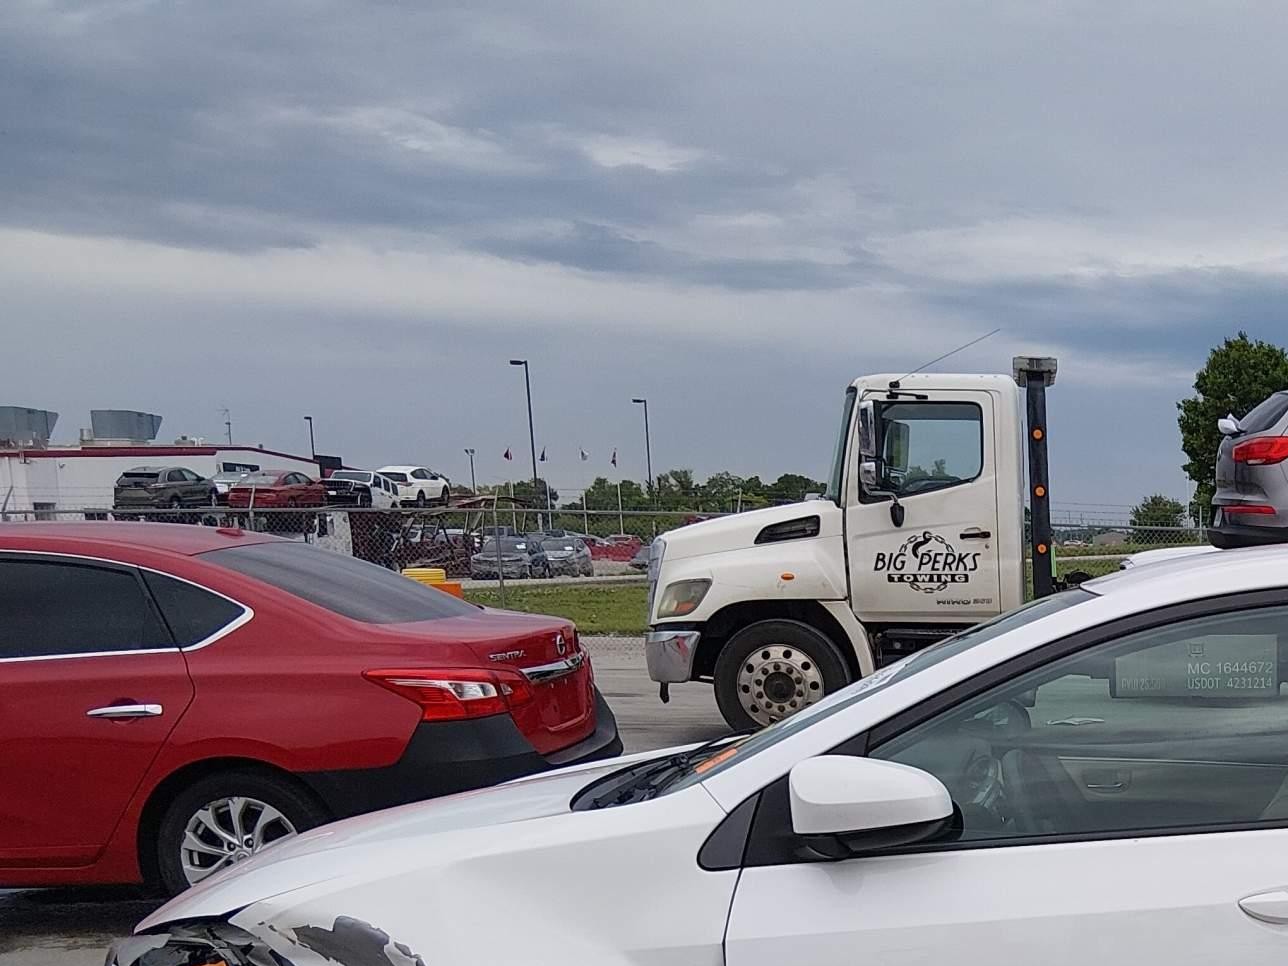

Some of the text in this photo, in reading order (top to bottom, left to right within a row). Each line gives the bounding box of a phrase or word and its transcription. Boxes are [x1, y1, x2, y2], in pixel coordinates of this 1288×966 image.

[873, 552, 982, 571] BIG PERKS
[889, 574, 967, 582] TOWING
[488, 650, 527, 662] SENTRA
[1187, 661, 1273, 675] MC 1644672
[1187, 677, 1221, 689] USDOT
